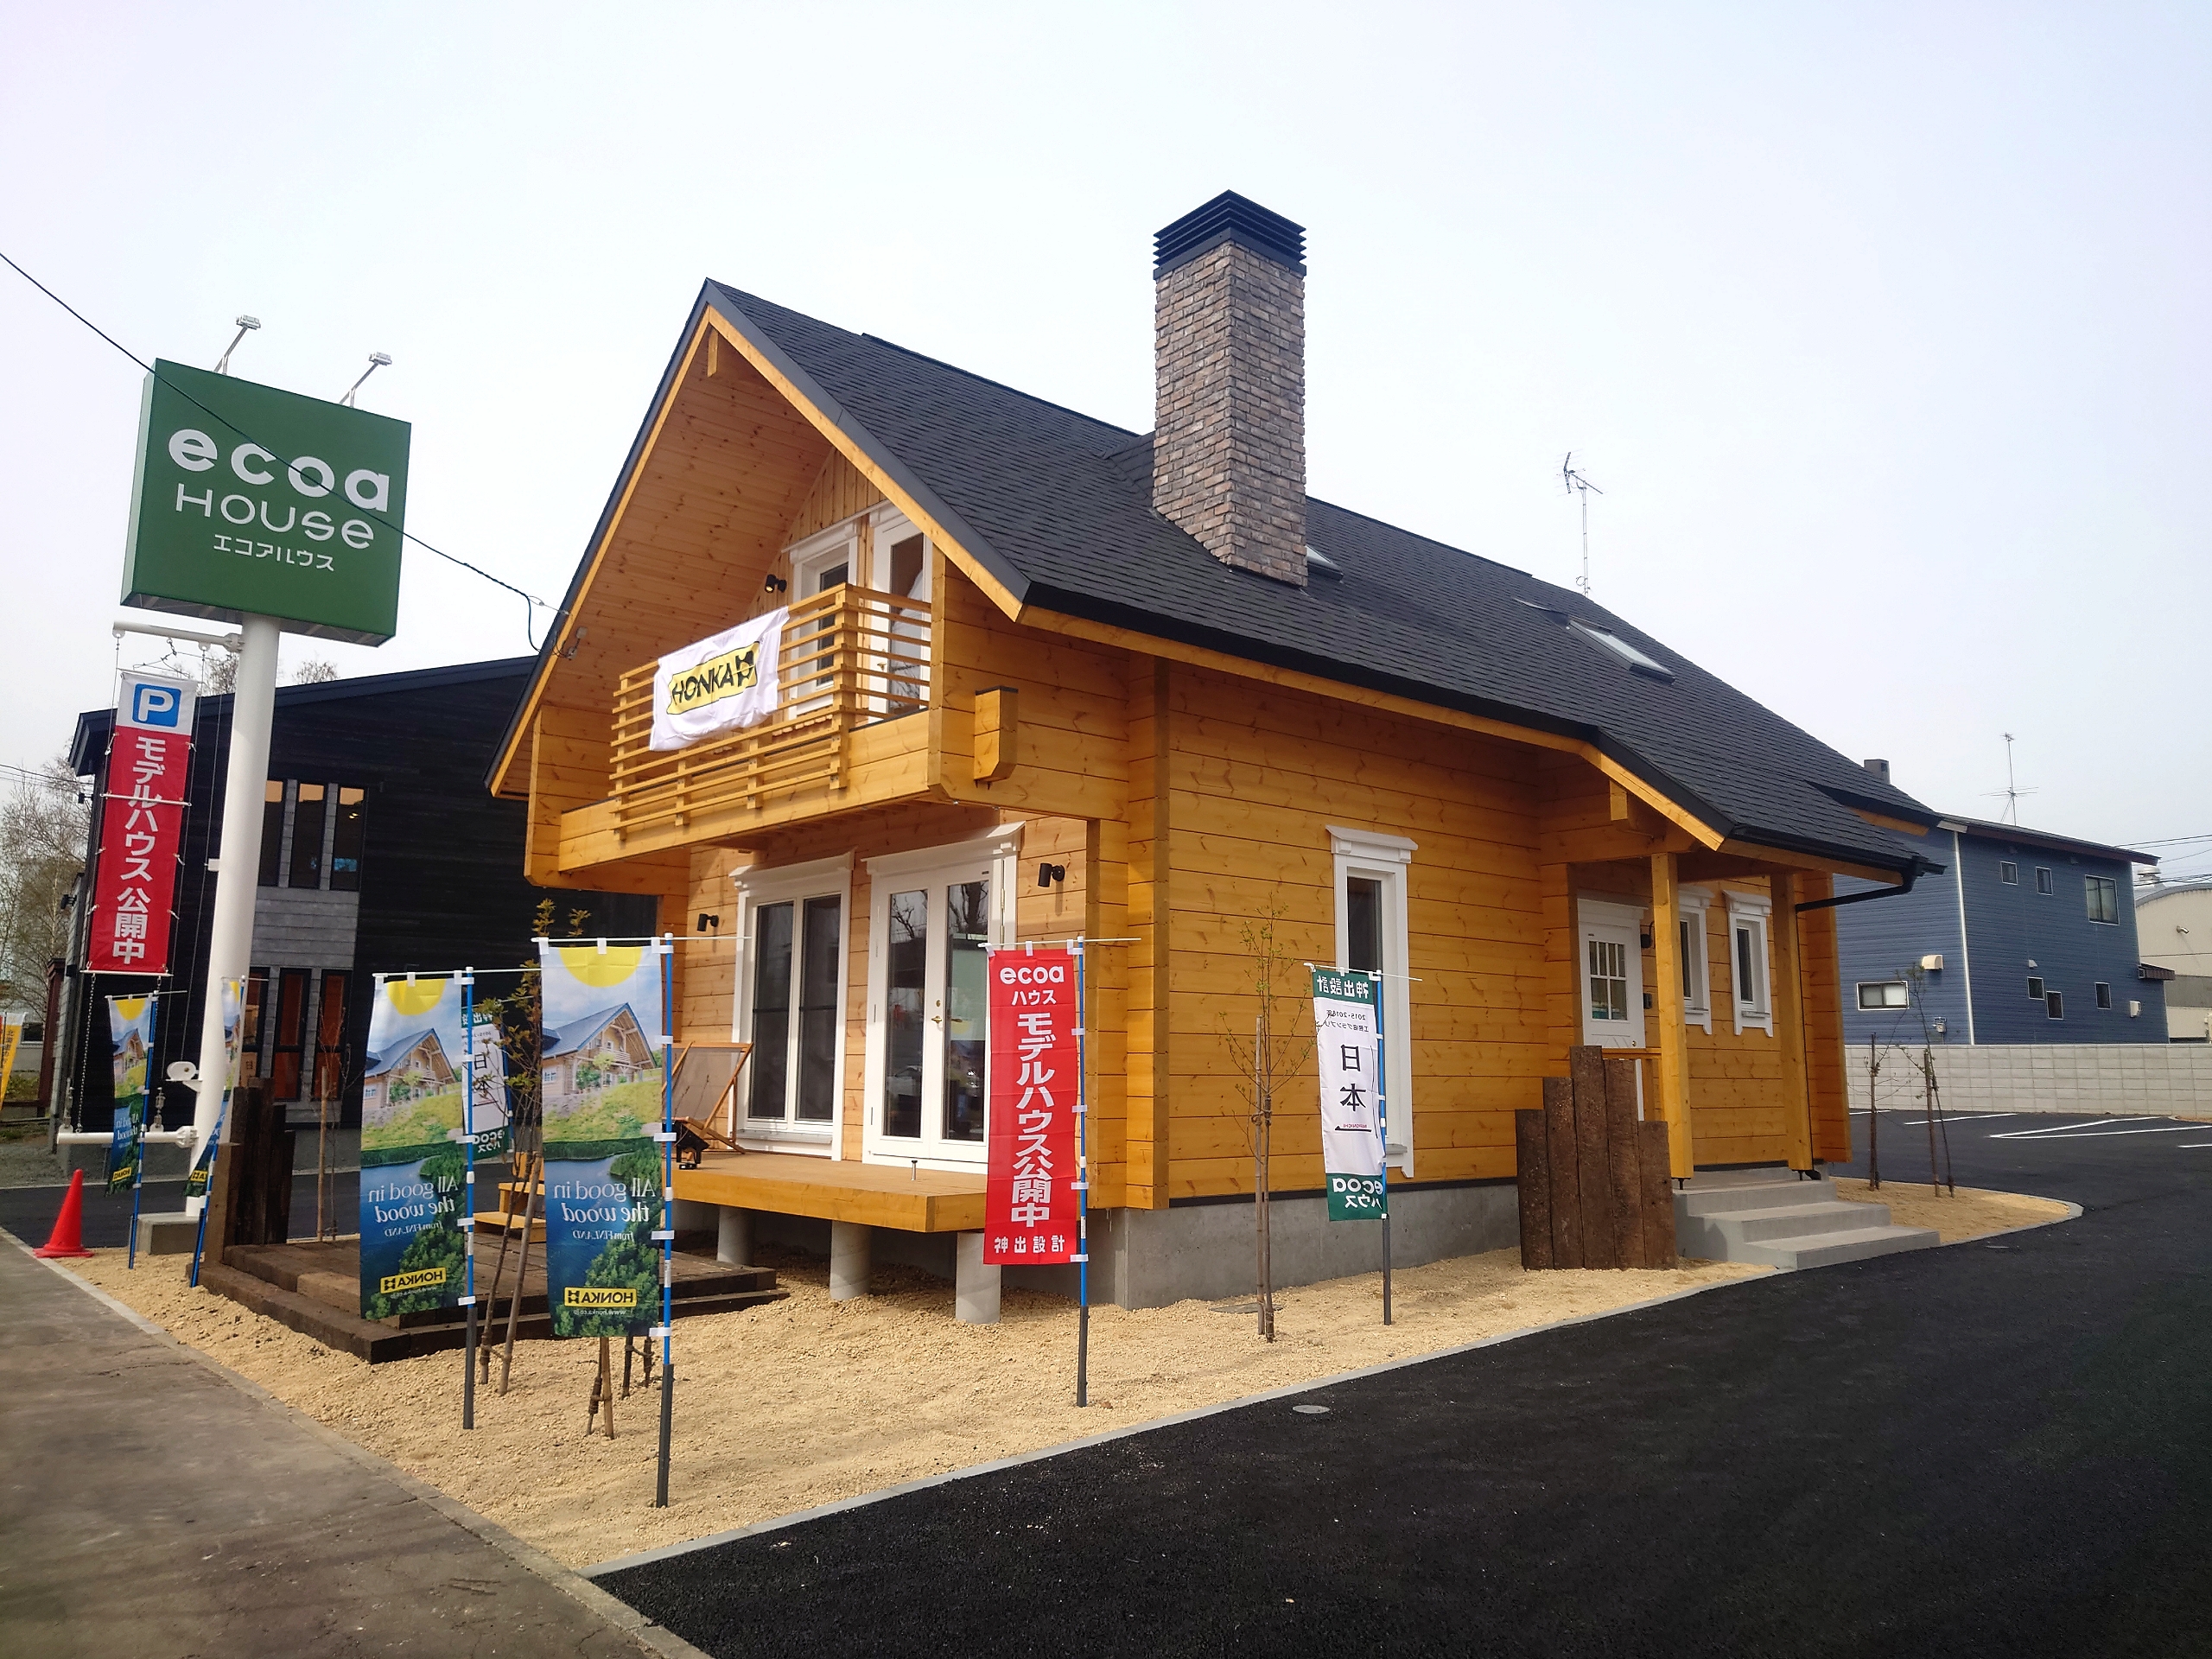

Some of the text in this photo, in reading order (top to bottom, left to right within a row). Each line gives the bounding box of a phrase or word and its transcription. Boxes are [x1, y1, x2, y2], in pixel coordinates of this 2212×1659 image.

[168, 429, 390, 512] ecoa
[672, 663, 734, 705] HONKA
[137, 688, 174, 722] P
[112, 735, 167, 965] モデルハウス公開中
[1000, 965, 1065, 985] ecoa
[1011, 989, 1058, 1006] ハウス
[1011, 1013, 1057, 1228] モデルハウス公開中
[994, 1235, 1065, 1254] 神出設計
